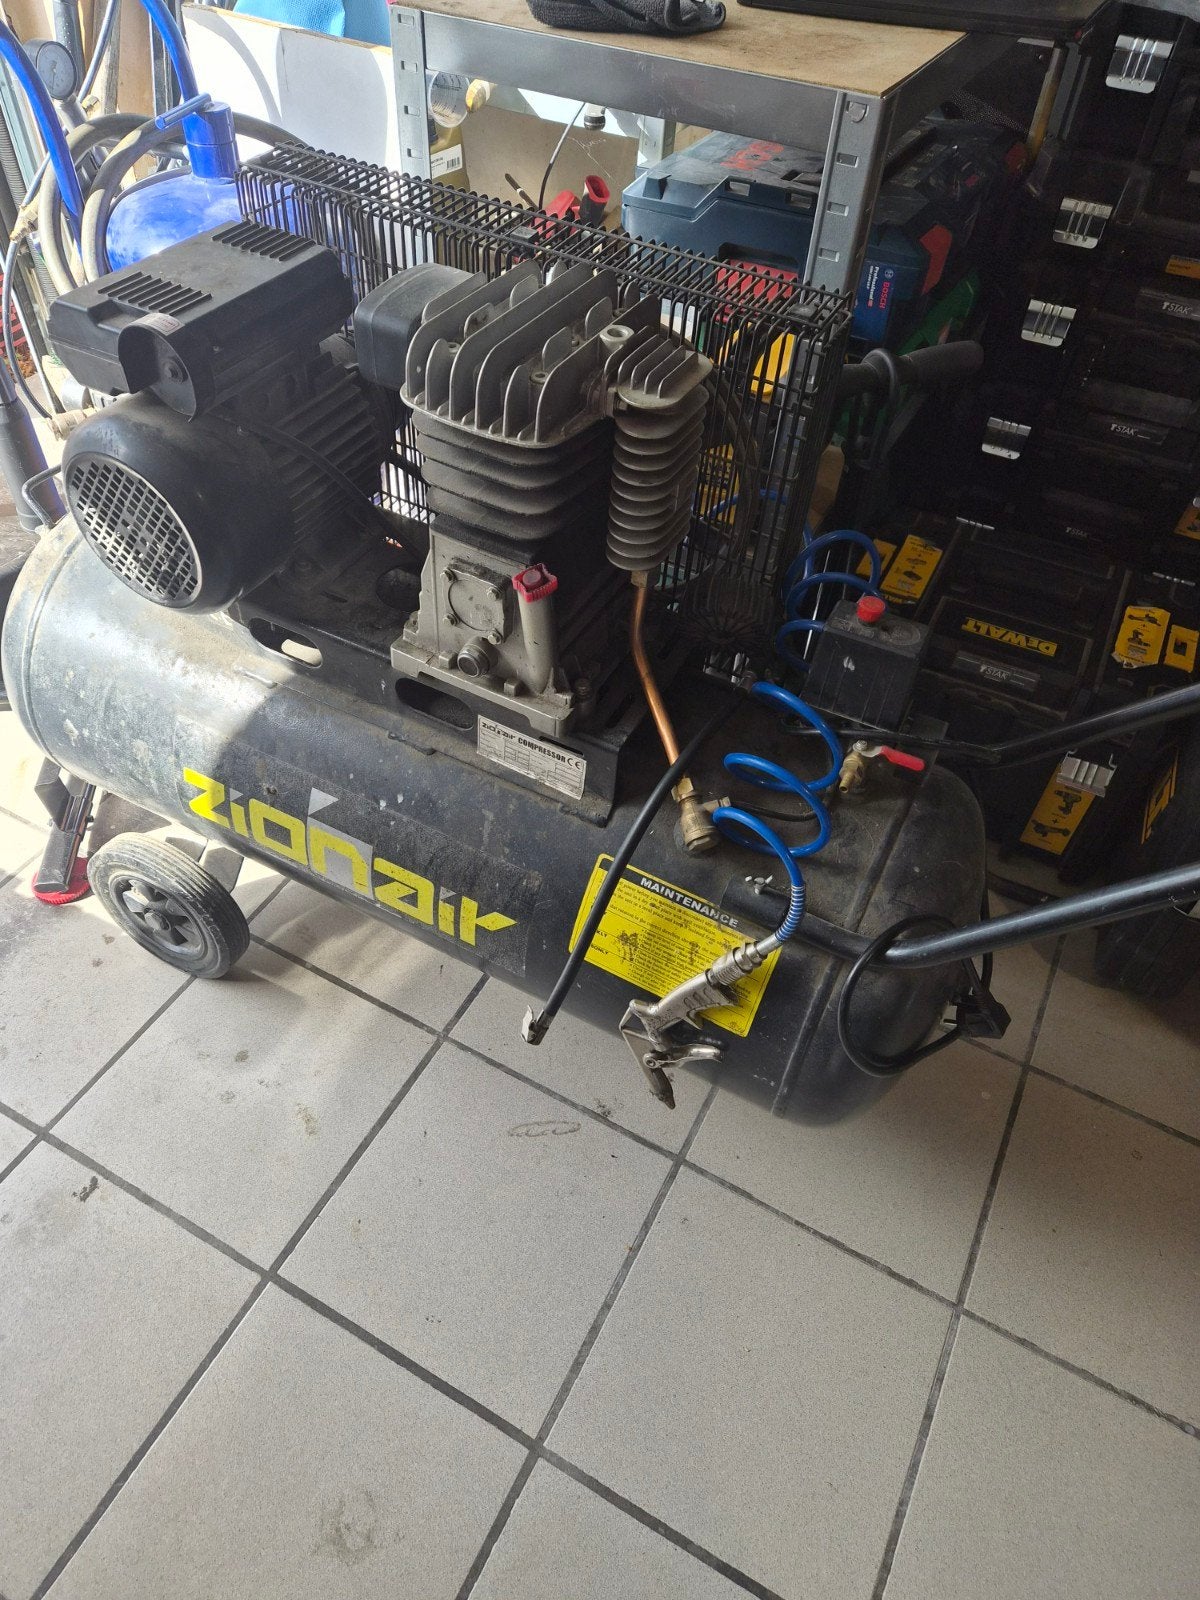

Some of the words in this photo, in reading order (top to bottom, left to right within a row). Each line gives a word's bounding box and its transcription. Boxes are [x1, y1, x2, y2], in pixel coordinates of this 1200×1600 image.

[879, 281, 891, 309] BOSCH
[518, 738, 566, 763] COMPRESSOR
[640, 877, 738, 928] MAINTENANCE
